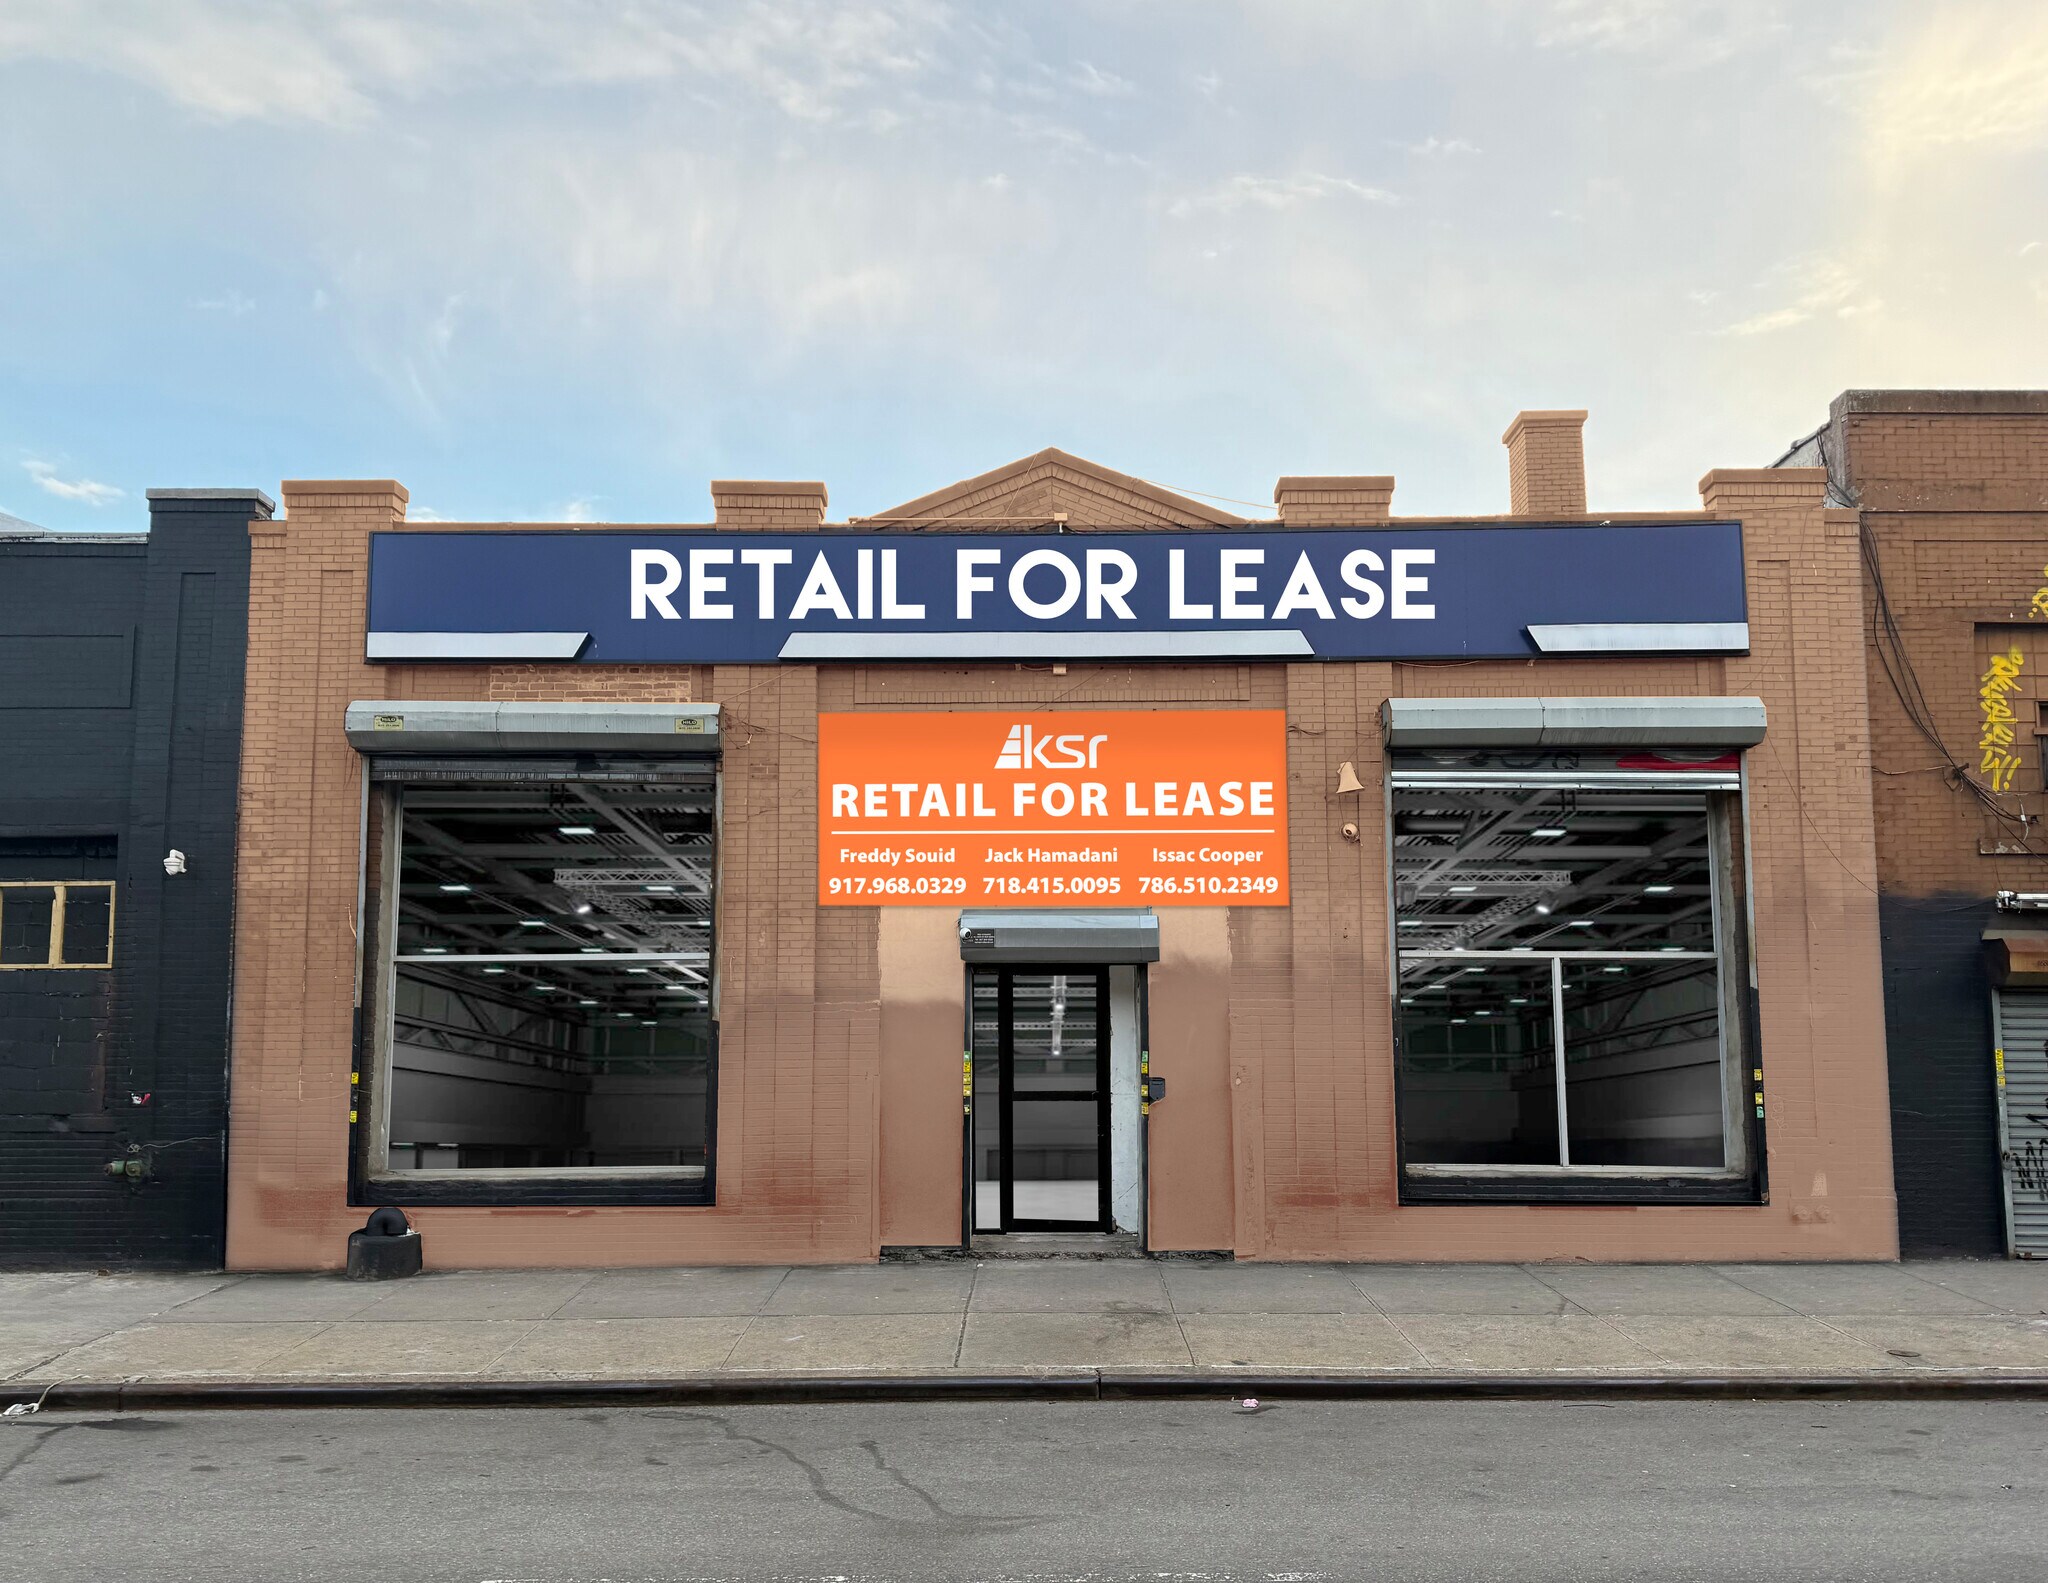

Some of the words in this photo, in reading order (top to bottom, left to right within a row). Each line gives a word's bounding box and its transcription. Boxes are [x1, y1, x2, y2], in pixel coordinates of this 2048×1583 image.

[630, 548, 926, 620] RETAIL
[956, 548, 1138, 620] FOR
[1169, 548, 1437, 620] LEASE
[832, 782, 997, 818] RETAIL
[1013, 781, 1109, 818] FOR
[1125, 781, 1275, 817] LEASE
[840, 847, 902, 867] Freddy
[905, 847, 956, 863] Souid
[984, 847, 1024, 863] Jack
[1027, 847, 1118, 863] Hamadani
[1152, 847, 1196, 863] Issac
[1198, 847, 1265, 866] Cooper
[828, 877, 967, 895] 917.968.0329
[982, 876, 1121, 894] 718.415.0095
[1138, 876, 1279, 894] 786.510.2349
